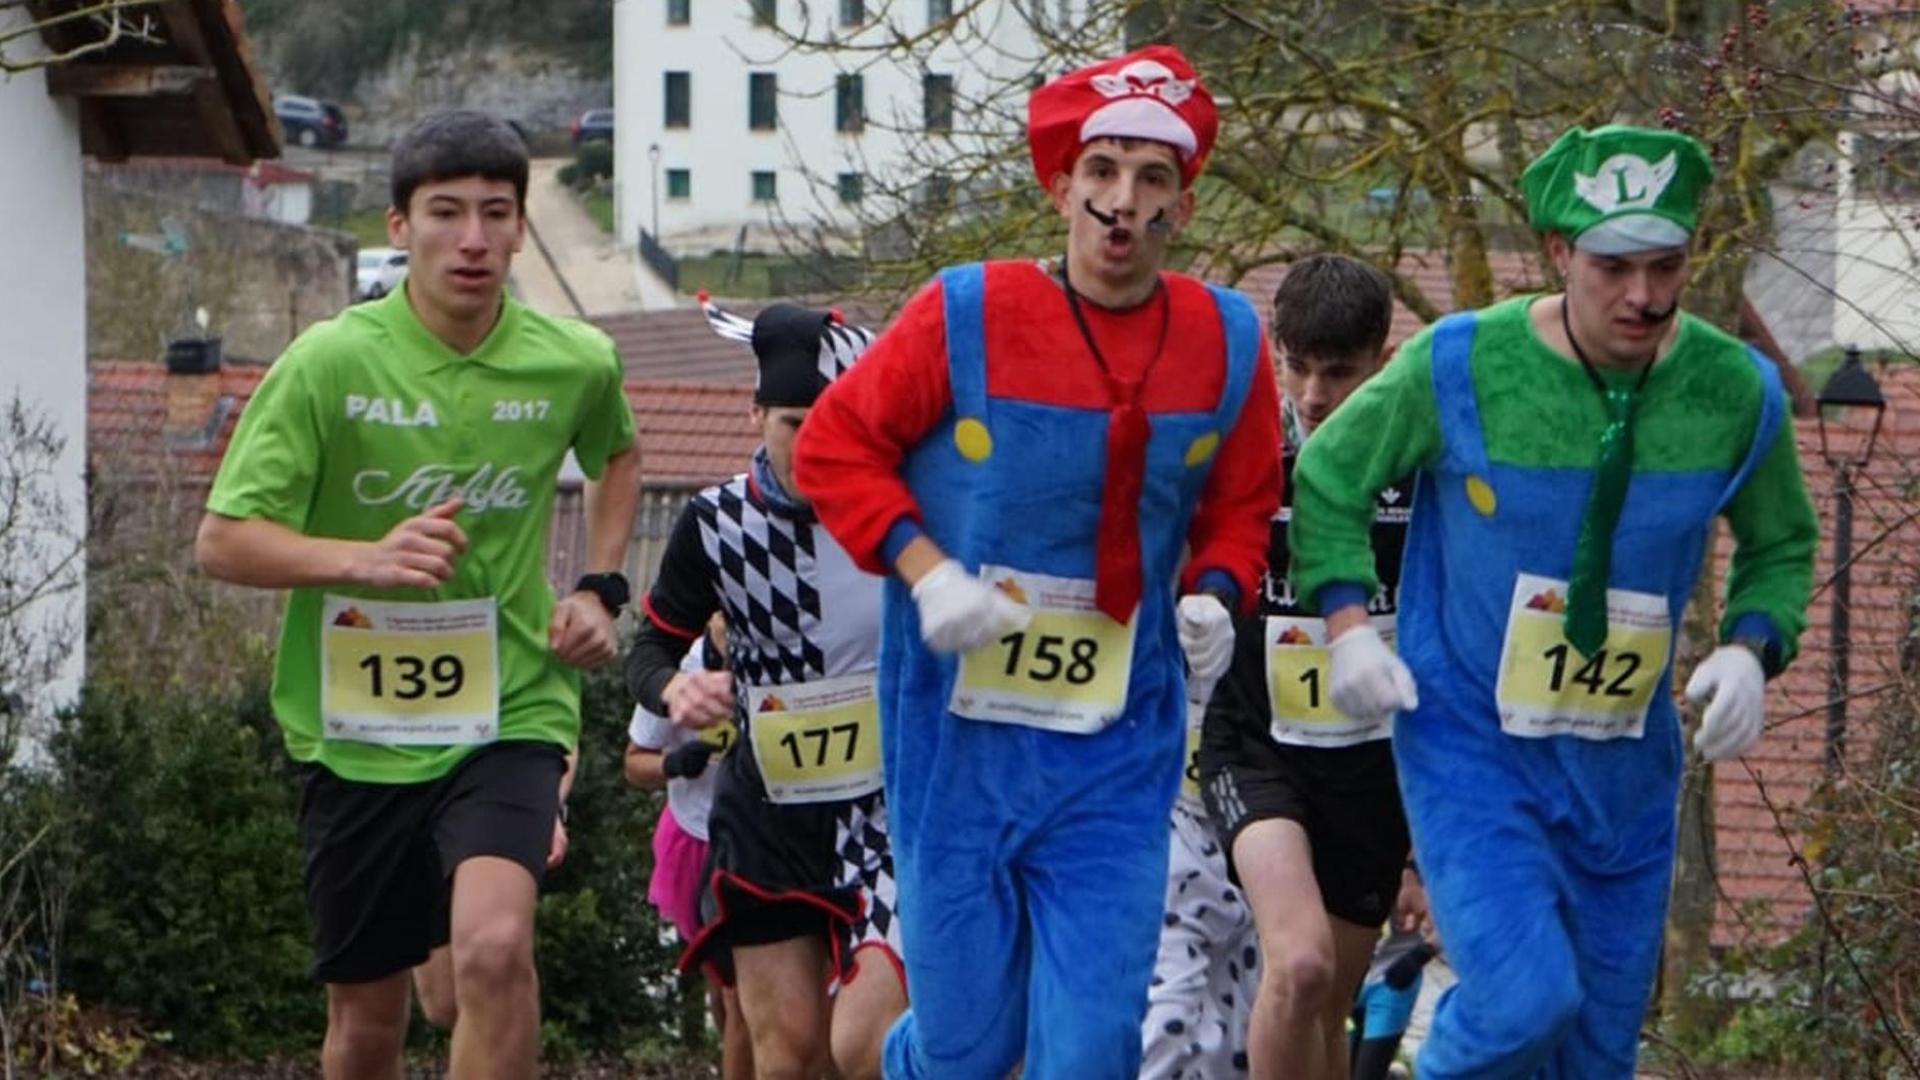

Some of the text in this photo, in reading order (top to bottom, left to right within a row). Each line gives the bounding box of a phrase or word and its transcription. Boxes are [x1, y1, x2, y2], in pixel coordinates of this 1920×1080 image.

[1611, 164, 1647, 204] L
[345, 394, 550, 427] PALA 2017
[358, 653, 465, 700] 139
[1000, 631, 1099, 685] 158
[1543, 643, 1642, 697] 142
[1299, 667, 1320, 709] 1
[780, 721, 860, 769] 177
